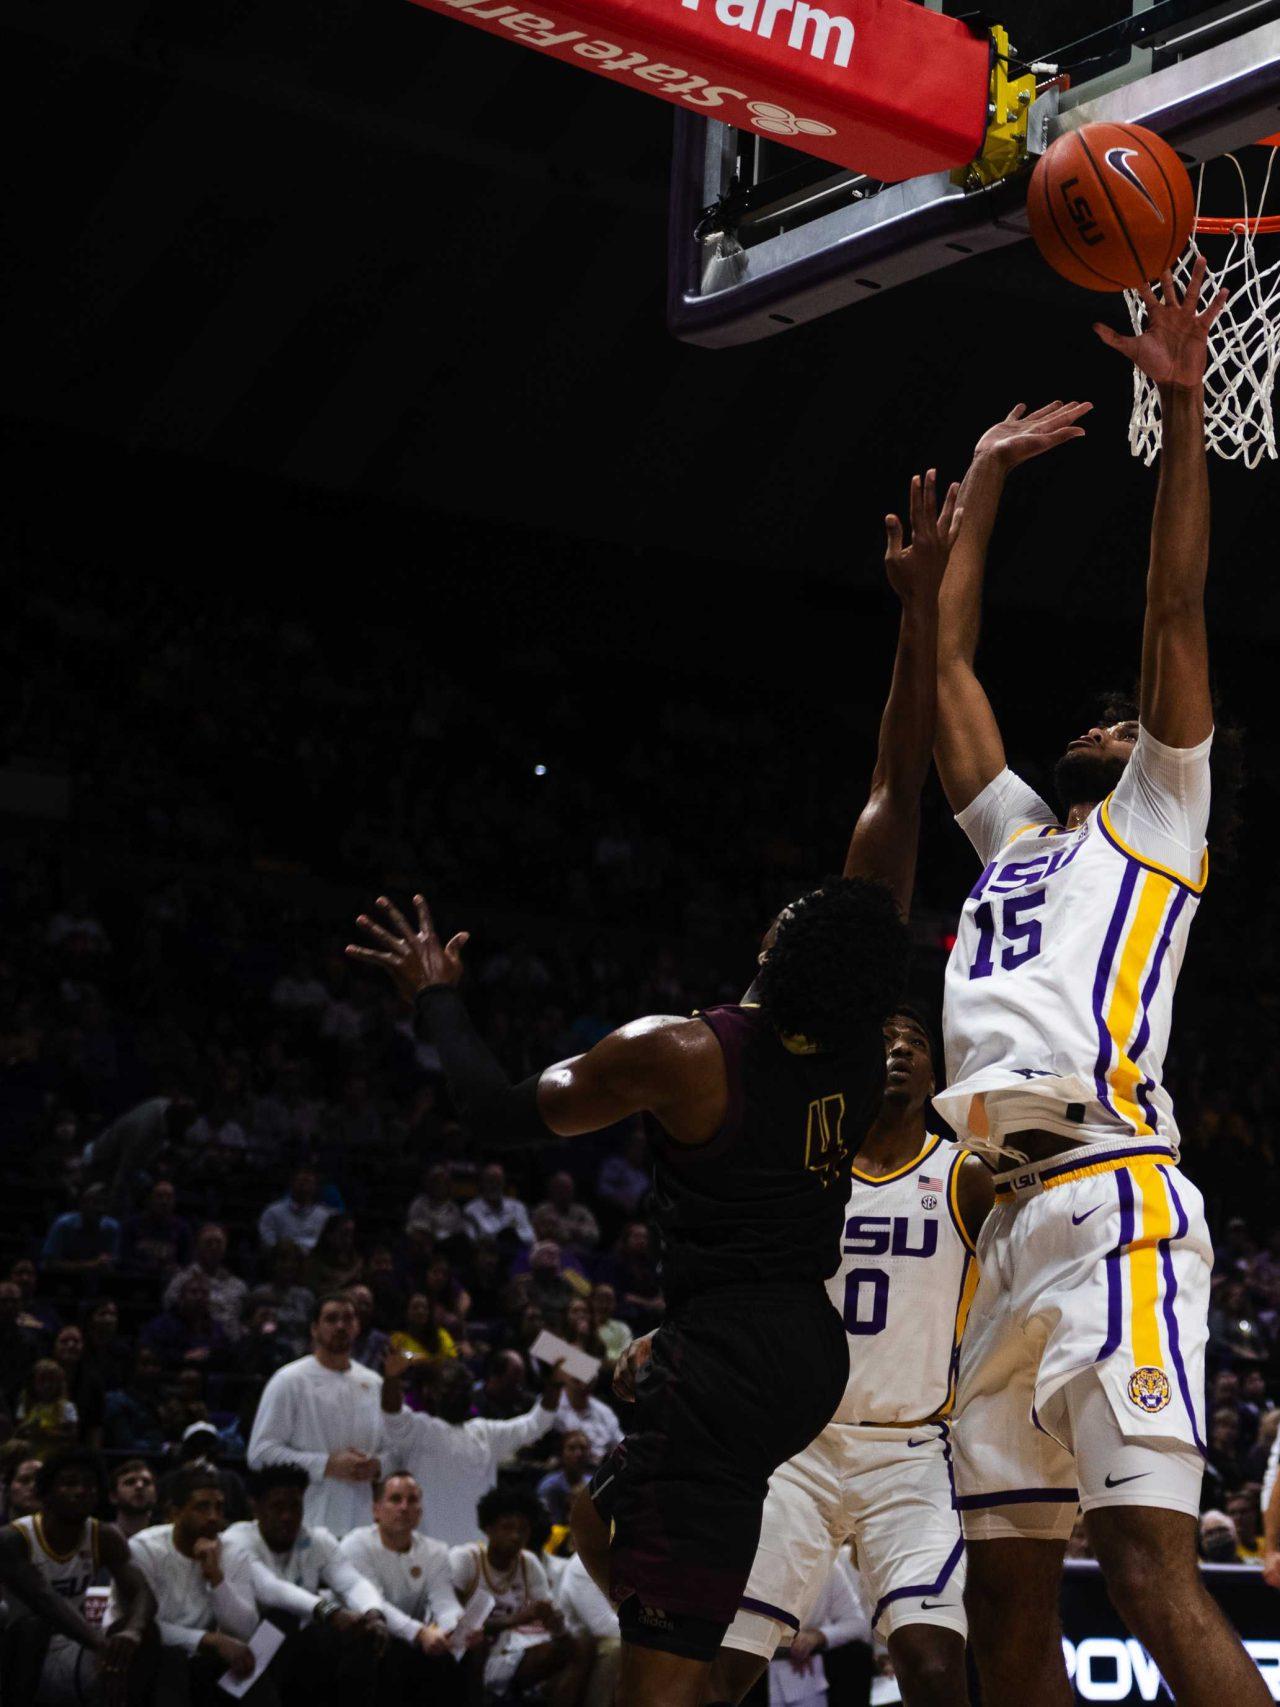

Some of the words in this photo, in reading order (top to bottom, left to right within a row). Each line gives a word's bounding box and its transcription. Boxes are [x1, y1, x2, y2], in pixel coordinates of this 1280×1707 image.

[682, 0, 856, 68] arm
[1060, 177, 1105, 246] LSU
[969, 888, 1047, 981] 15
[1013, 1172, 1036, 1190] LSU
[844, 1268, 889, 1336] 0
